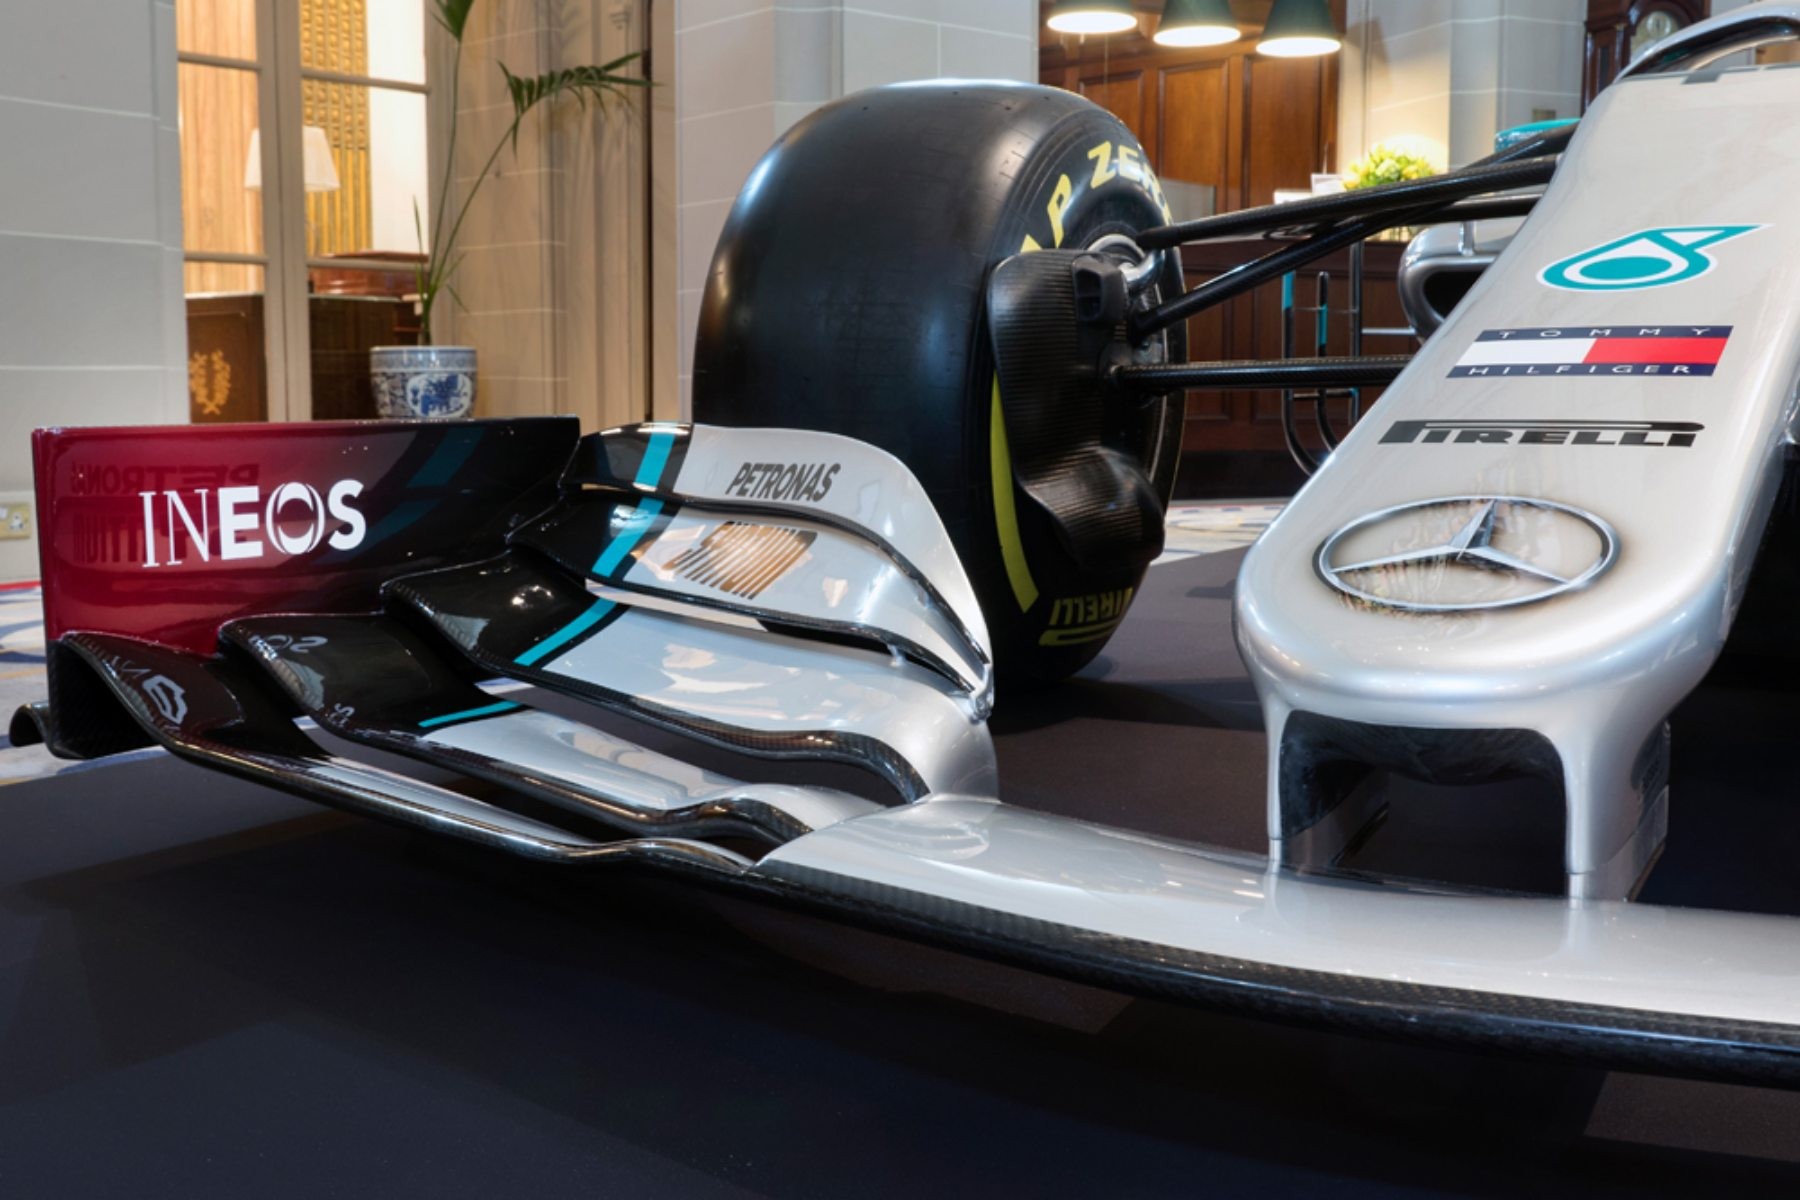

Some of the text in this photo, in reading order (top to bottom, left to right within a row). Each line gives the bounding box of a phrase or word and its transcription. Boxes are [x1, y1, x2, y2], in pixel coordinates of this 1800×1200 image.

[1047, 173, 1072, 248] P
[1499, 328, 1710, 339] TOMMY
[1468, 364, 1690, 375] HILFIGER
[1378, 419, 1705, 447] PIRELLI
[725, 462, 841, 502] PETRONAS
[138, 479, 366, 567] INEOS
